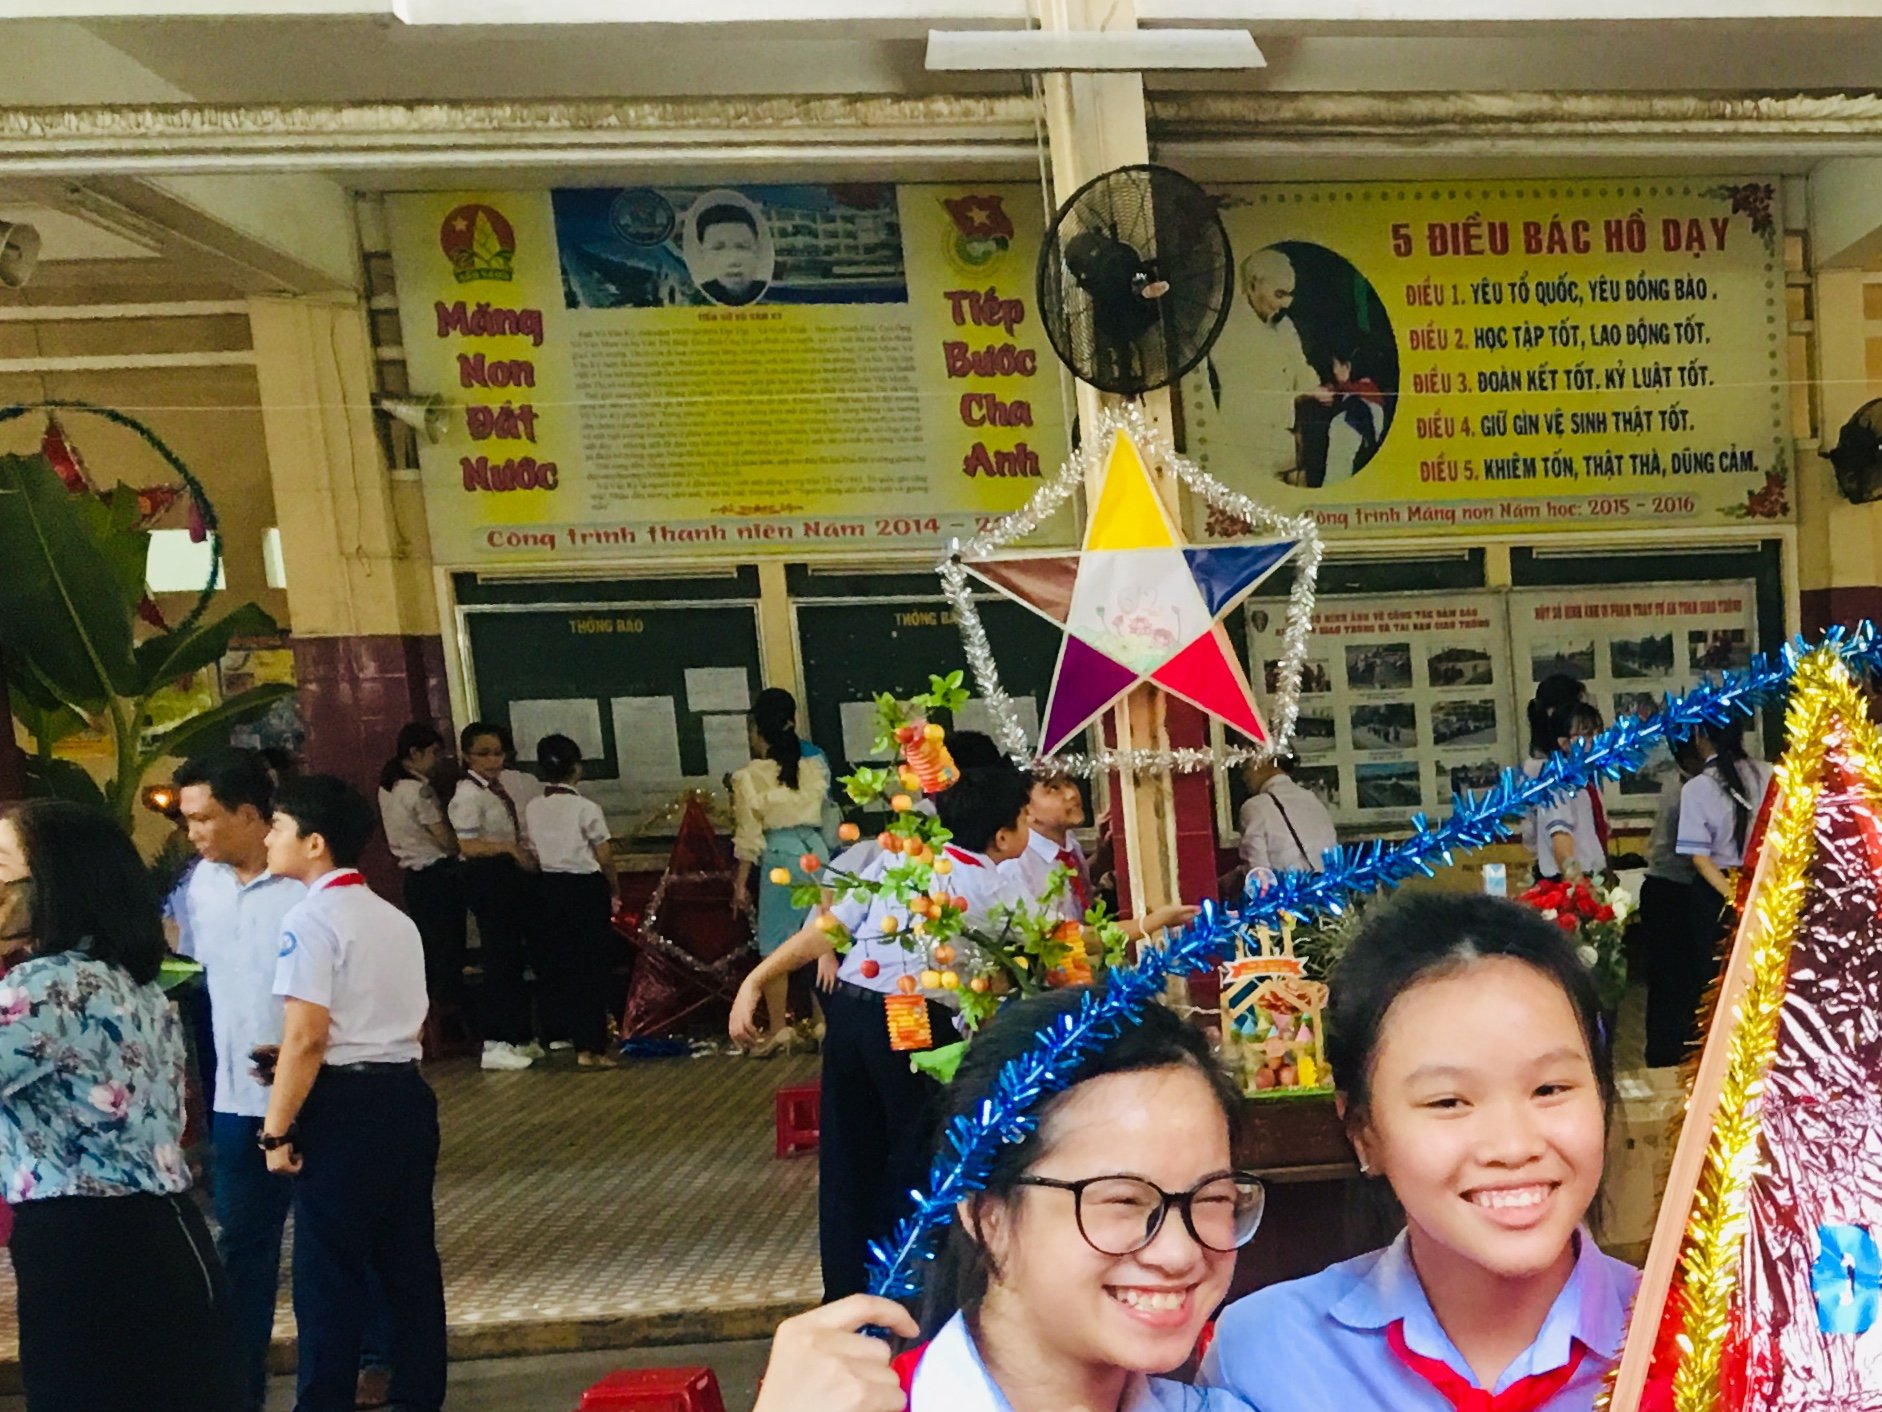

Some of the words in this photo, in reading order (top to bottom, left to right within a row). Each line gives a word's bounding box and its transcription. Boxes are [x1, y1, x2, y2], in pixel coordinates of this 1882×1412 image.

[1391, 222, 1413, 257] 5
[1427, 211, 1510, 257] ĐIỀU
[1523, 214, 1590, 255] BÁC
[1603, 207, 1647, 254] HỒ
[1662, 217, 1729, 258] DẠY
[1405, 275, 1444, 307] ĐIỀU
[1452, 284, 1466, 306] 1.
[1470, 276, 1502, 305] YÊU
[1507, 270, 1530, 305] TỔ
[1535, 271, 1583, 307] QUỐC,
[1588, 274, 1620, 303] YÊU
[1625, 270, 1669, 301] ĐỒNG
[434, 300, 543, 347] Măng
[944, 286, 1025, 339] Tiếp
[1409, 320, 1448, 351] ĐIỀU
[1454, 328, 1469, 350] 2.
[1474, 325, 1508, 353] HỌC
[1512, 320, 1545, 352] TẬP
[1549, 316, 1586, 350] TỐT,
[1590, 323, 1621, 347] LAO
[1626, 317, 1670, 349] ĐỘNG
[1674, 314, 1711, 345] TỐT.
[457, 353, 536, 390] Non
[942, 339, 1037, 379] Bước
[1413, 363, 1451, 394] ĐIỀU
[1457, 372, 1472, 393] 3.
[1477, 365, 1522, 393] ĐOÀN
[1526, 361, 1558, 392] KẾT
[1605, 359, 1626, 389] KỶ
[1632, 361, 1673, 394] LUẬT
[1677, 357, 1714, 387] TỐT.
[465, 399, 539, 444] Đất
[960, 393, 1034, 428] Cha
[1416, 408, 1455, 439] ĐIỀU
[1460, 416, 1476, 438] 4.
[1480, 408, 1508, 437] GIỮ
[1513, 409, 1540, 436] GÌN
[1543, 407, 1565, 439] VỆ
[1570, 410, 1607, 435] SINH
[1612, 405, 1653, 437] THẬT
[1658, 401, 1695, 432] TỐT.
[459, 456, 559, 492] Nước
[962, 441, 1042, 480] Anh
[1420, 451, 1458, 483] ĐIỀU
[1463, 460, 1479, 481] 5.
[1483, 451, 1537, 480] KHIÊM
[1541, 448, 1578, 482] TỐN,
[1583, 449, 1624, 481] THẬT
[1629, 447, 1667, 478] THÀ,
[1671, 446, 1715, 475] DŨNG
[1718, 443, 1759, 472] CẢM.
[1355, 506, 1400, 525] trình
[1462, 505, 1494, 520] non
[1547, 501, 1583, 519] học:
[1587, 499, 1630, 517] 2015
[1652, 496, 1695, 514] 2016
[486, 529, 556, 551] Công
[567, 526, 636, 545] trình
[647, 523, 727, 545] thanh
[736, 523, 794, 541] niên
[874, 517, 941, 536] 2014
